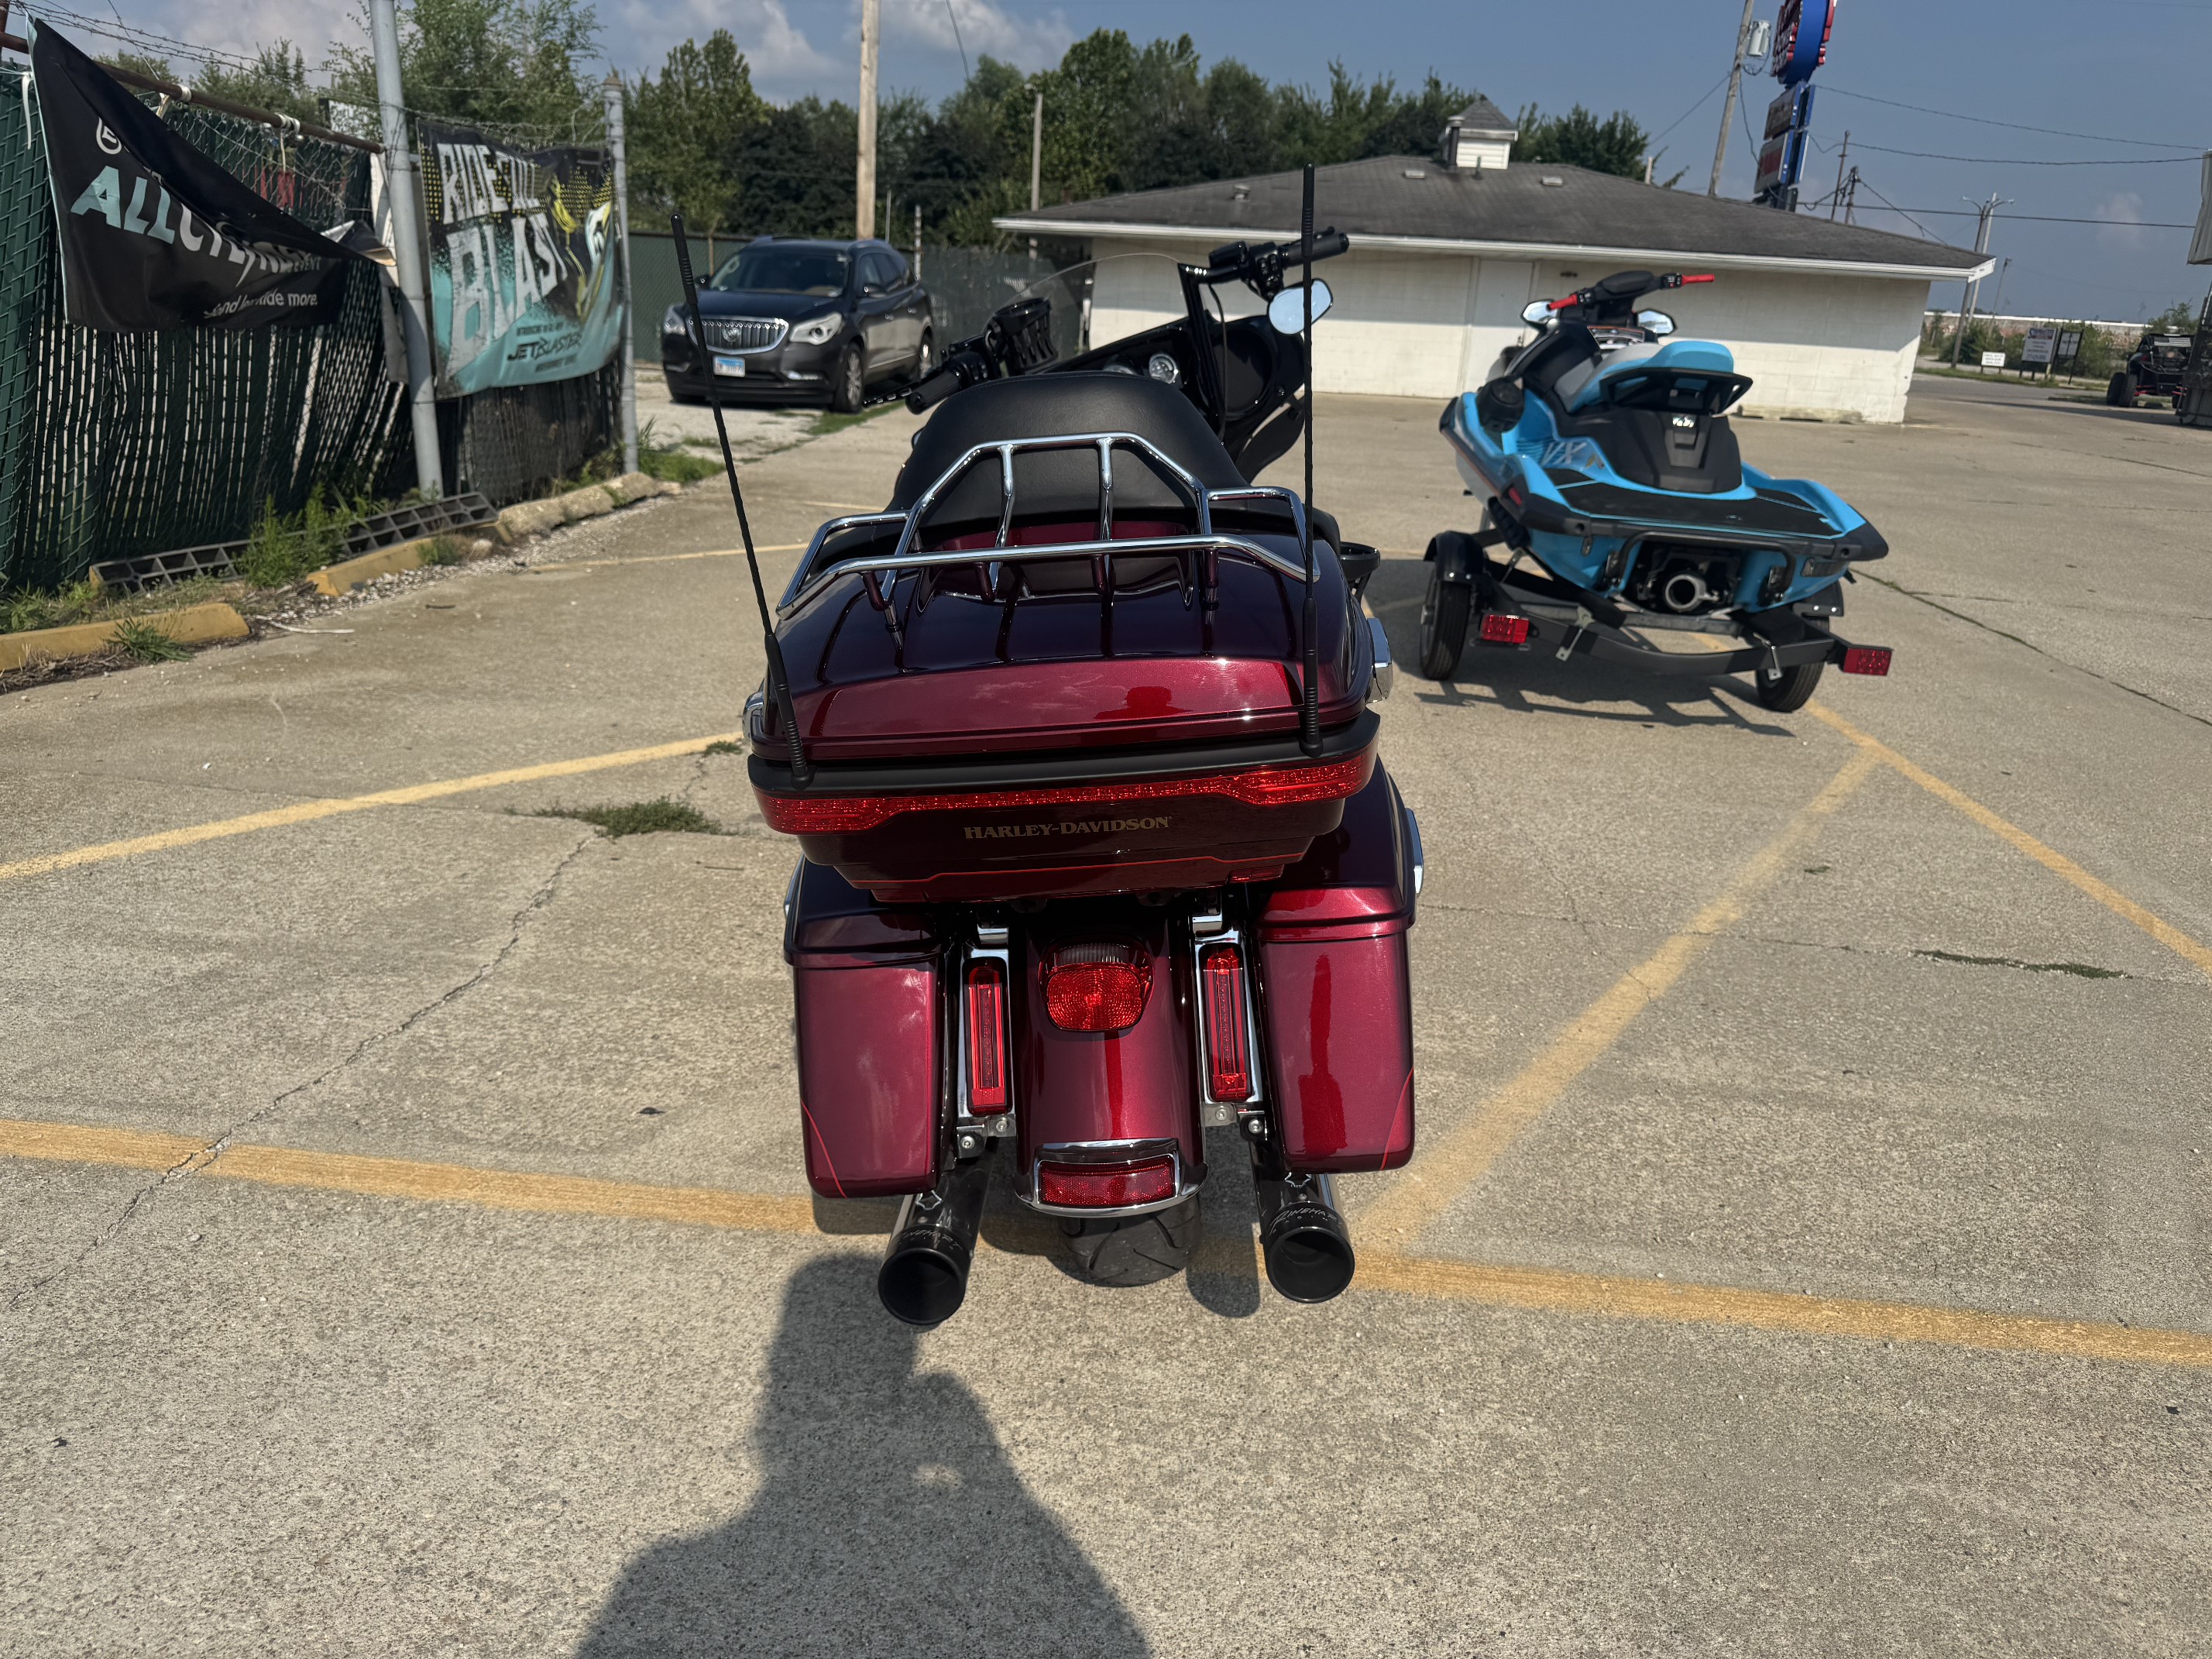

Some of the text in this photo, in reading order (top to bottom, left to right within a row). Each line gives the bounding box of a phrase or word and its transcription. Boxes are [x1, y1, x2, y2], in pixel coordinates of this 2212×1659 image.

[436, 143, 510, 225] RIDE
[287, 292, 318, 307] more.
[445, 211, 568, 377] BLAST
[1541, 441, 1587, 467] VX
[963, 816, 1170, 840] HARLEY-DAVIDSON
